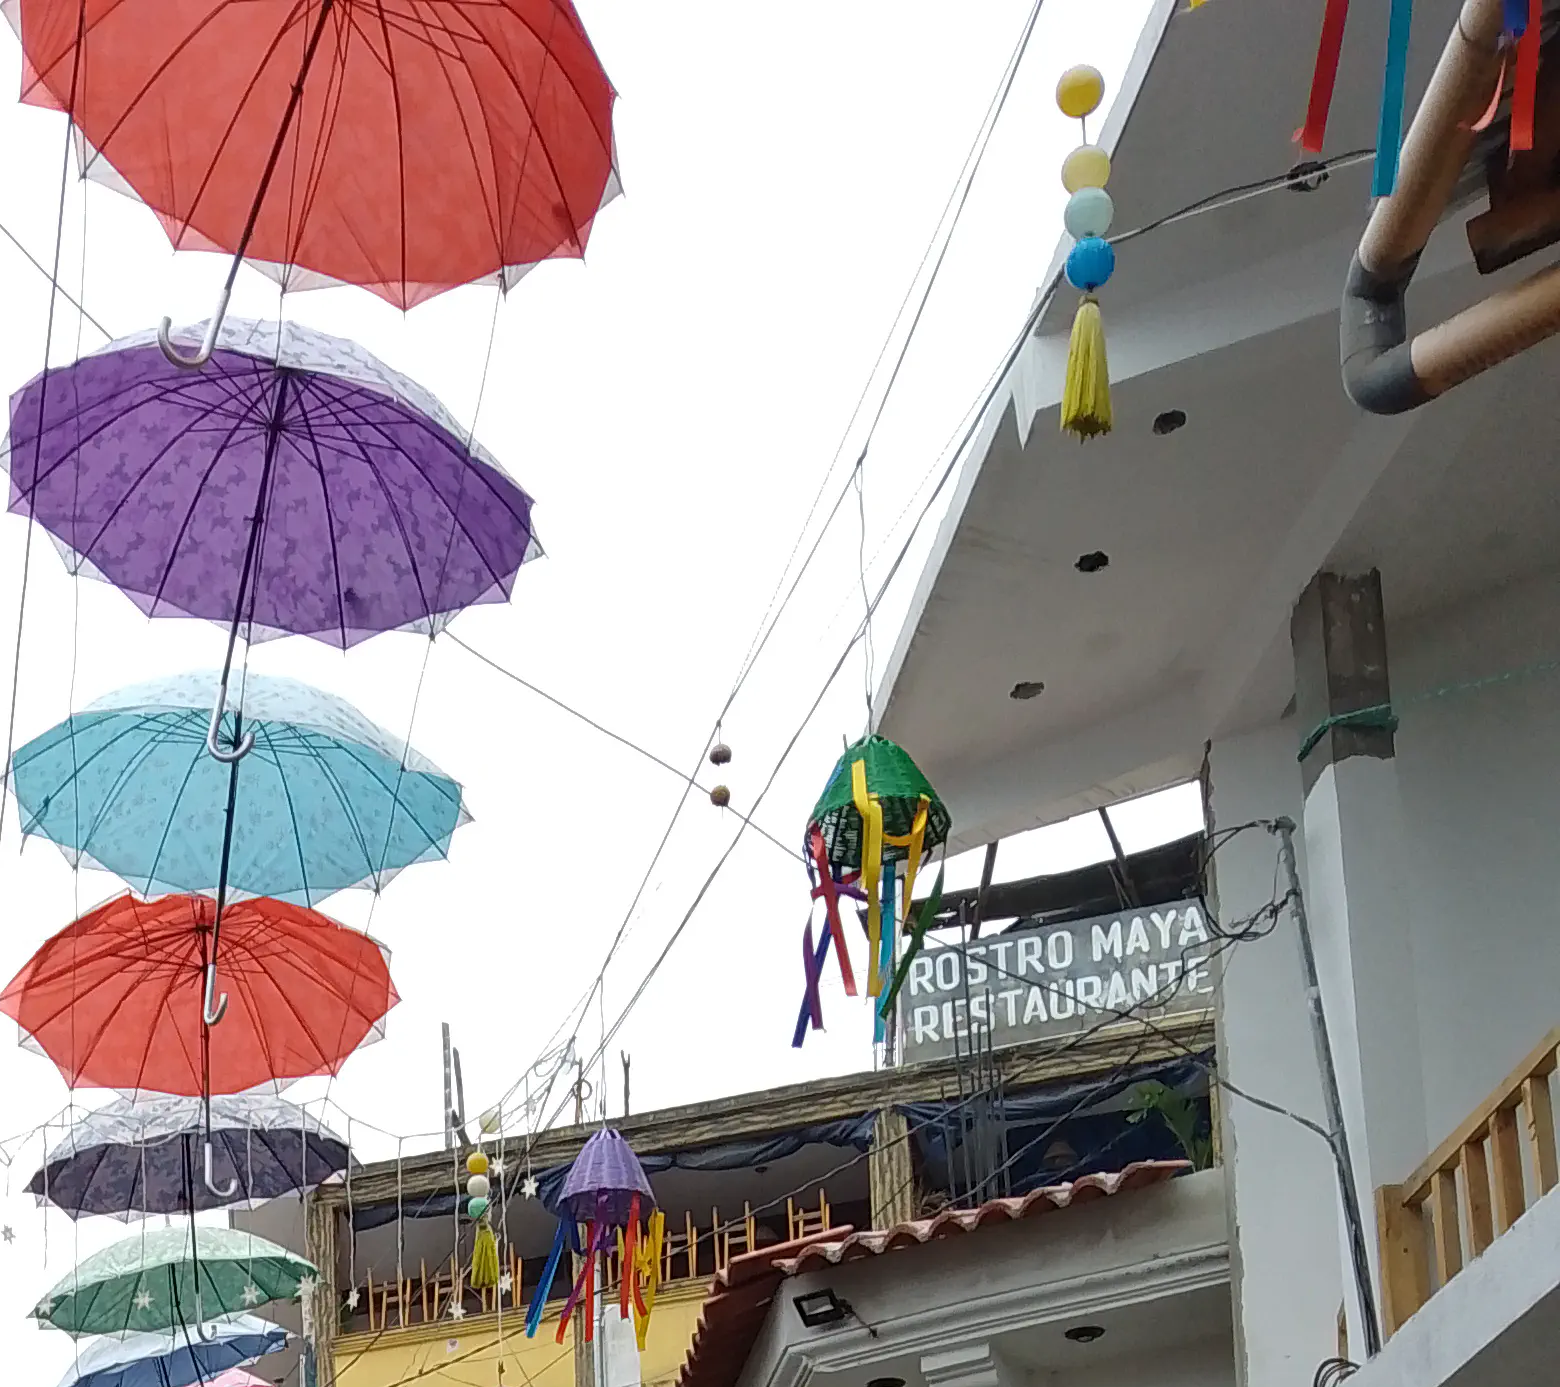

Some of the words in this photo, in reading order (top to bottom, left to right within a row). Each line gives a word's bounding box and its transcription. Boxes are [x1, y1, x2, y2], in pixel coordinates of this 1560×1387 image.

[909, 930, 1073, 996] ROSTRO
[1090, 906, 1209, 963] MAYA
[913, 956, 1215, 1044] RESTAURANTE
